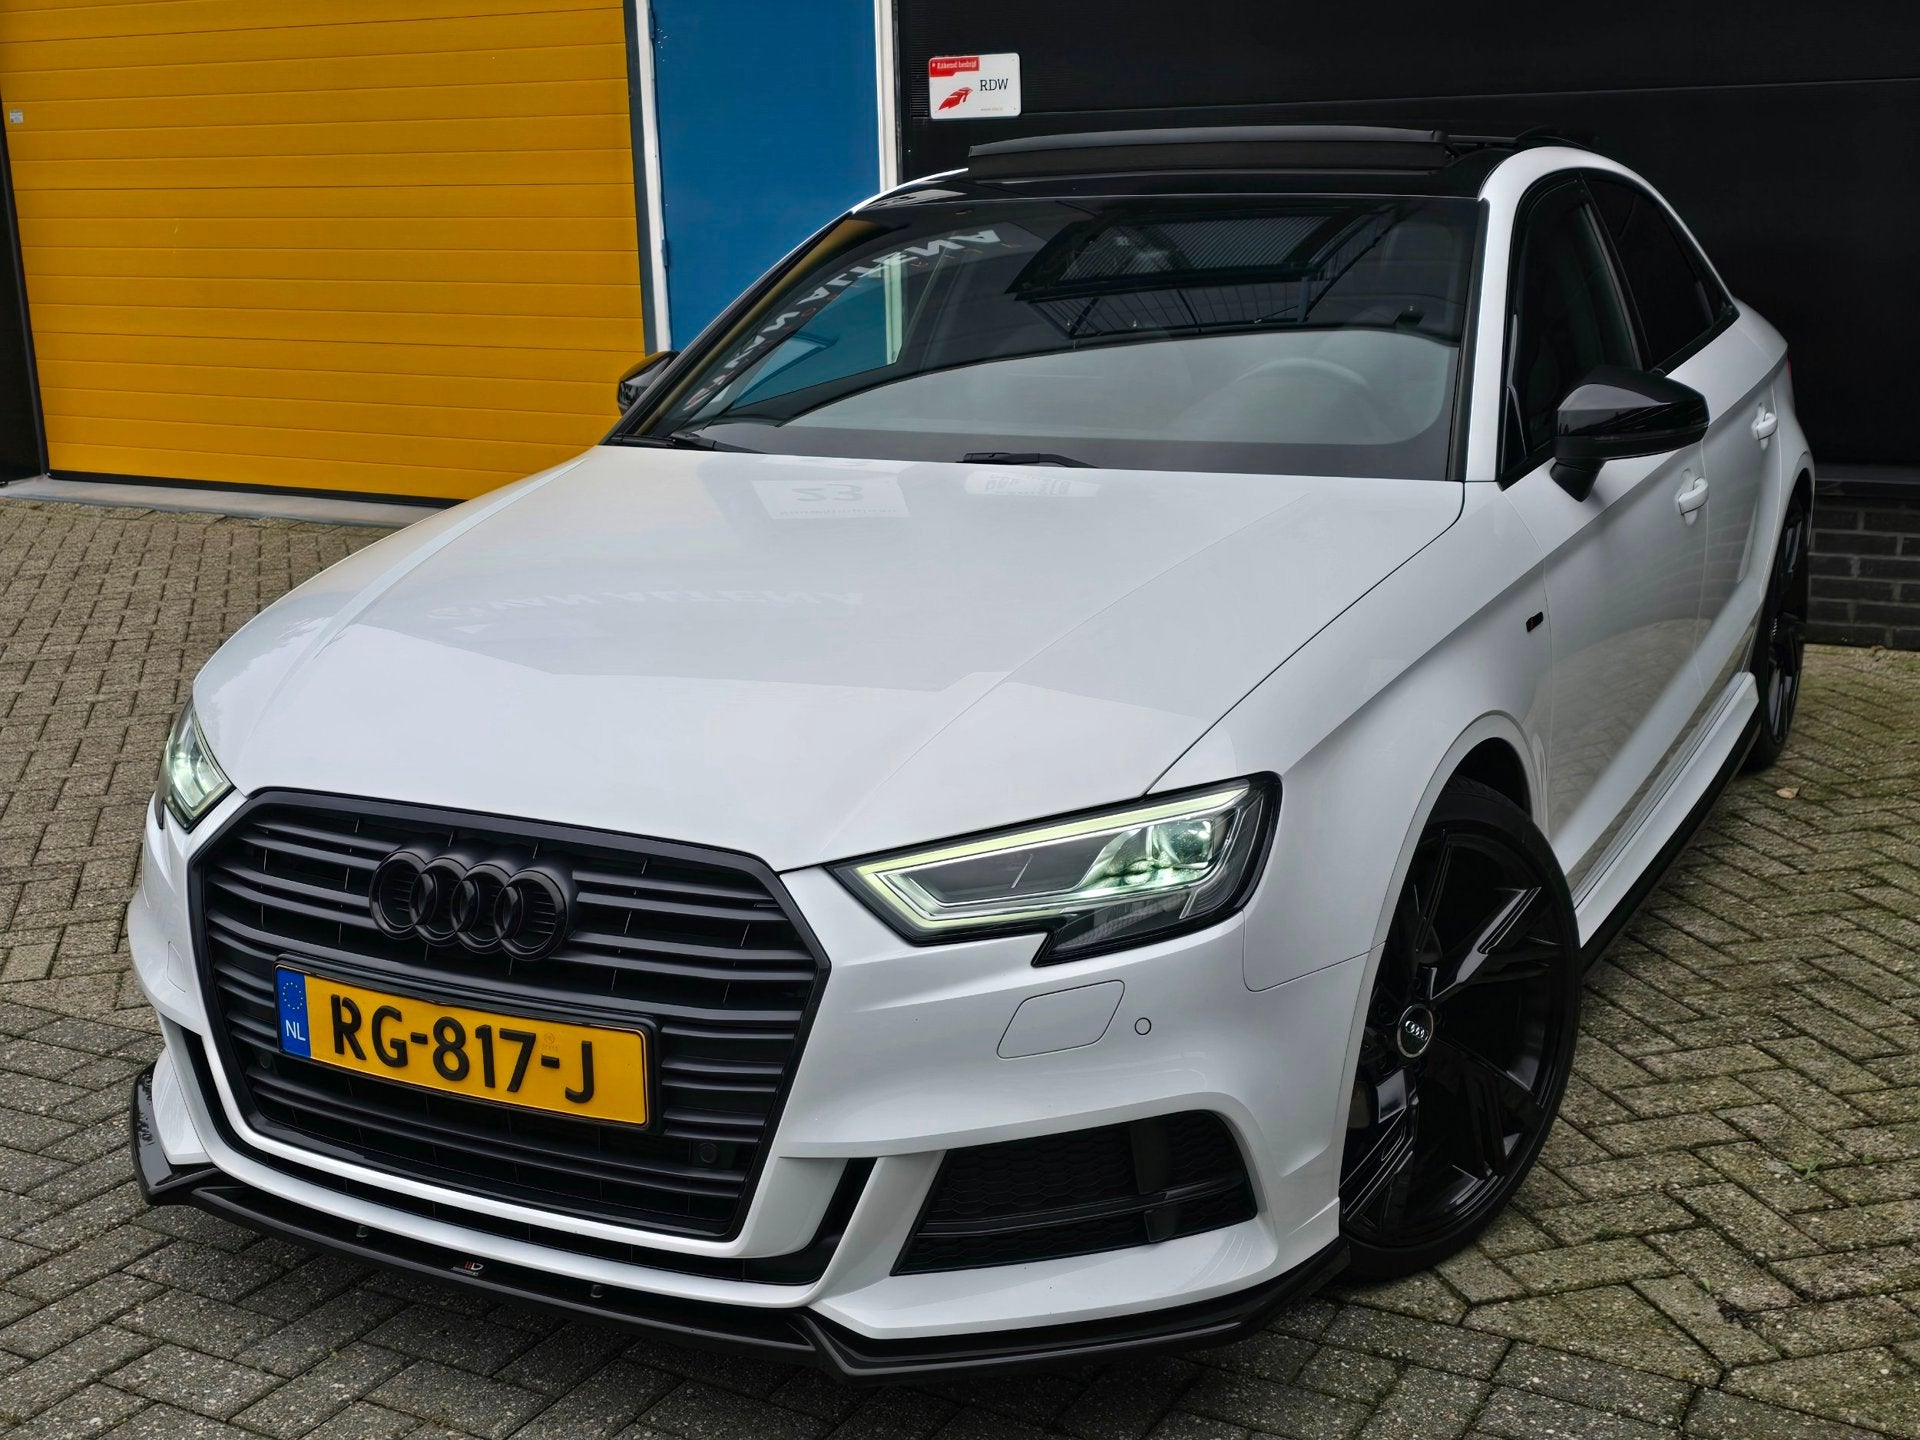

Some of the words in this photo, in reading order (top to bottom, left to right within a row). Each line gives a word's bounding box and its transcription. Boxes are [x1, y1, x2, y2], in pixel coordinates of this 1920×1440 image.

[980, 78, 1009, 91] RDW
[285, 1019, 306, 1042] NL
[330, 994, 596, 1104] RG-817-J
